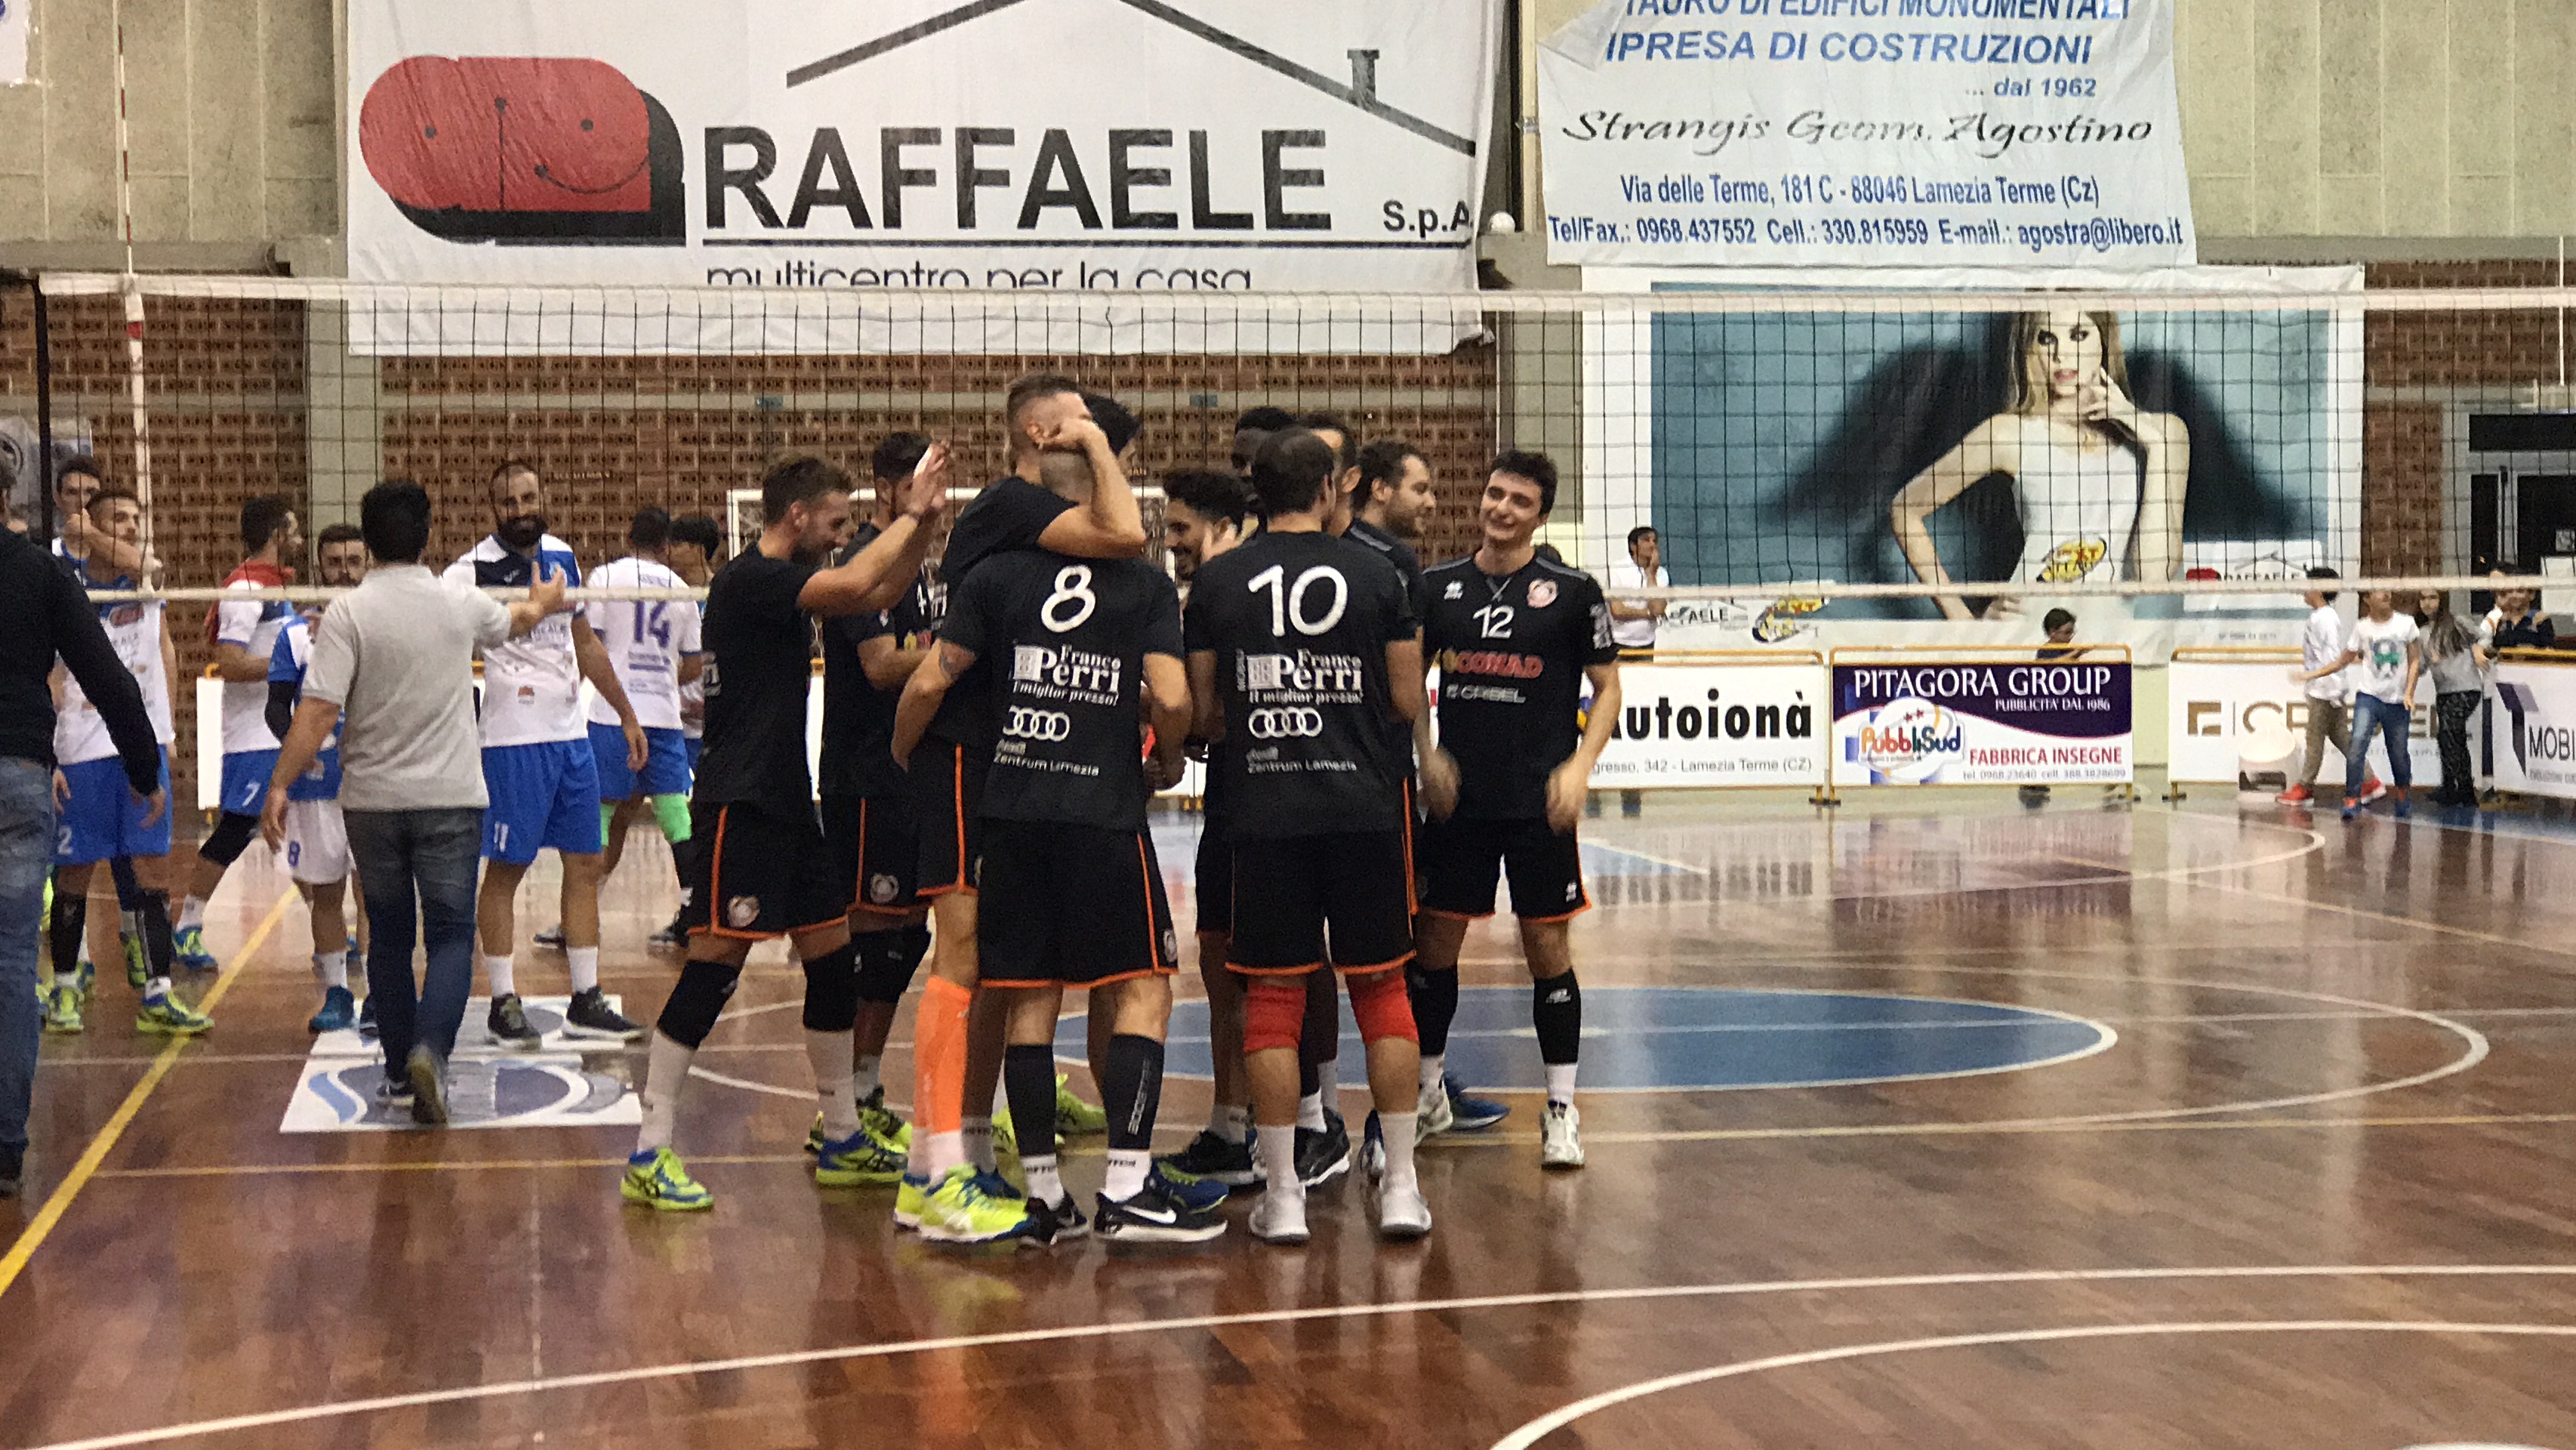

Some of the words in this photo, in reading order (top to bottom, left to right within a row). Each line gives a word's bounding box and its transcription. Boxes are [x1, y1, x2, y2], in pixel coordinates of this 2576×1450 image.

[1768, 32, 1807, 60] DI
[1820, 32, 2094, 64] COSTRUZIONI
[1994, 78, 2031, 97] dal
[2041, 79, 2097, 97] 1962
[1562, 110, 1770, 156] Strangis
[1942, 111, 2152, 159] Agostino
[704, 126, 1333, 231] RAFFAELE
[1620, 174, 1652, 203] Via
[1658, 173, 1704, 203] delle
[1709, 172, 1775, 208] Terme,
[1781, 174, 1812, 203] 181
[1819, 174, 1833, 203] C
[1850, 174, 1907, 204] 88046
[1912, 175, 1992, 204] Lamezia
[1995, 176, 2056, 204] Terme
[2061, 174, 2099, 209] (Cz)
[1636, 217, 1757, 244] 0968.437552
[1821, 218, 1928, 245] 330.815959
[2017, 217, 2183, 252] agostra@libero.it
[1041, 565, 1096, 633] 8
[1247, 565, 1348, 637] 10
[634, 600, 670, 648] 14
[1473, 605, 1514, 639] 12
[1032, 646, 1120, 693] Perri
[1061, 643, 1121, 670] Franco
[1272, 652, 1362, 691] Perri
[1854, 668, 1998, 699] PITAGORA
[2008, 667, 2111, 696] GROUP
[1611, 688, 1812, 740] utoionà
[1861, 726, 1961, 754] PubbliSud
[1970, 748, 2048, 766] FABBRICA
[2052, 746, 2122, 765] INSEGNE
[1681, 758, 1735, 773] Lamezia
[1738, 757, 1779, 773] Terme
